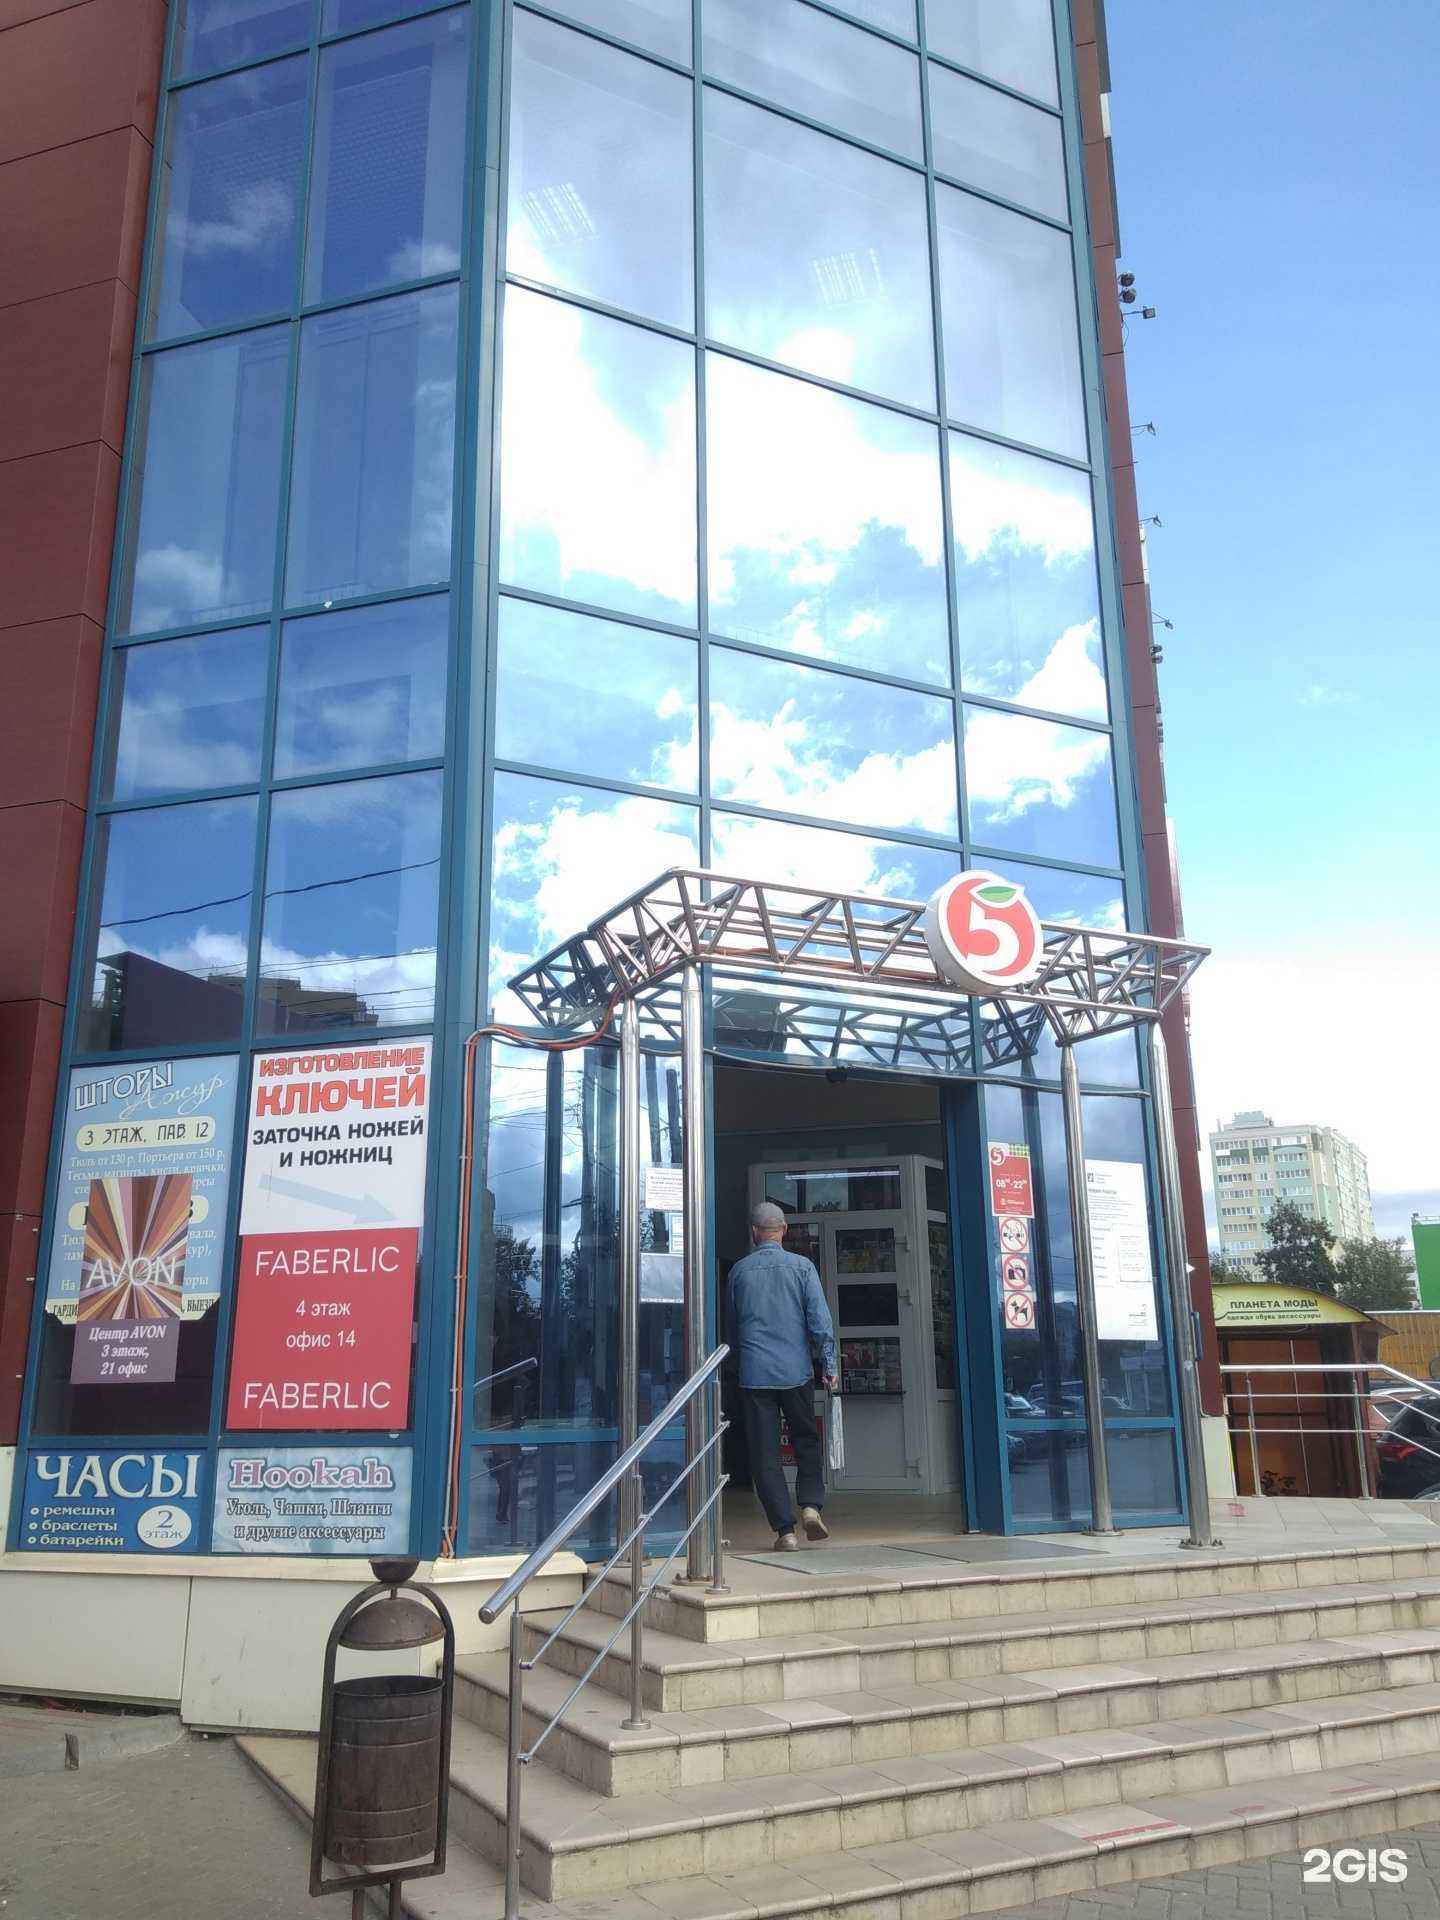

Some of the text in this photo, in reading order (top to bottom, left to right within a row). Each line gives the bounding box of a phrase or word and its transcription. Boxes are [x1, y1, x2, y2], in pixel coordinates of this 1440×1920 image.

[258, 1046, 426, 1078] ИЗГОТОВЛЕНИЕ
[74, 1061, 175, 1112] ШТОРЫ
[255, 1068, 427, 1118] КЛЮЧЕЙ
[84, 1130, 94, 1146] 3
[102, 1126, 147, 1145] ЭТАЖ.
[195, 1121, 209, 1138] 12
[252, 1118, 425, 1146] ЗАТОЧКА НОЖЕЙ
[279, 1146, 394, 1169] И НОЖНИЦ
[254, 1246, 401, 1276] FABERLIC
[85, 1256, 176, 1289] AVON
[52, 1303, 79, 1318] ГАРДИ
[295, 1301, 352, 1317] 4 этаж
[1229, 1299, 1319, 1309] ПЛАНЕТА МОДЫ
[88, 1324, 167, 1343] Центр AVON
[285, 1330, 356, 1352] офис 14
[100, 1344, 150, 1360] 3 этаж,
[100, 1361, 148, 1377] 21 офис
[243, 1381, 392, 1410] FABERLIC
[34, 1453, 201, 1499] ЧАСЫ
[228, 1459, 394, 1490] Hookah
[42, 1504, 116, 1518] ремешки
[156, 1510, 174, 1528] 2
[225, 1497, 393, 1519] Уголь, Чашки, Шланги
[41, 1518, 119, 1532] браслеты
[142, 1527, 183, 1541] этаж
[233, 1525, 385, 1544] и другие аксессуары
[39, 1533, 125, 1547] батарейки
